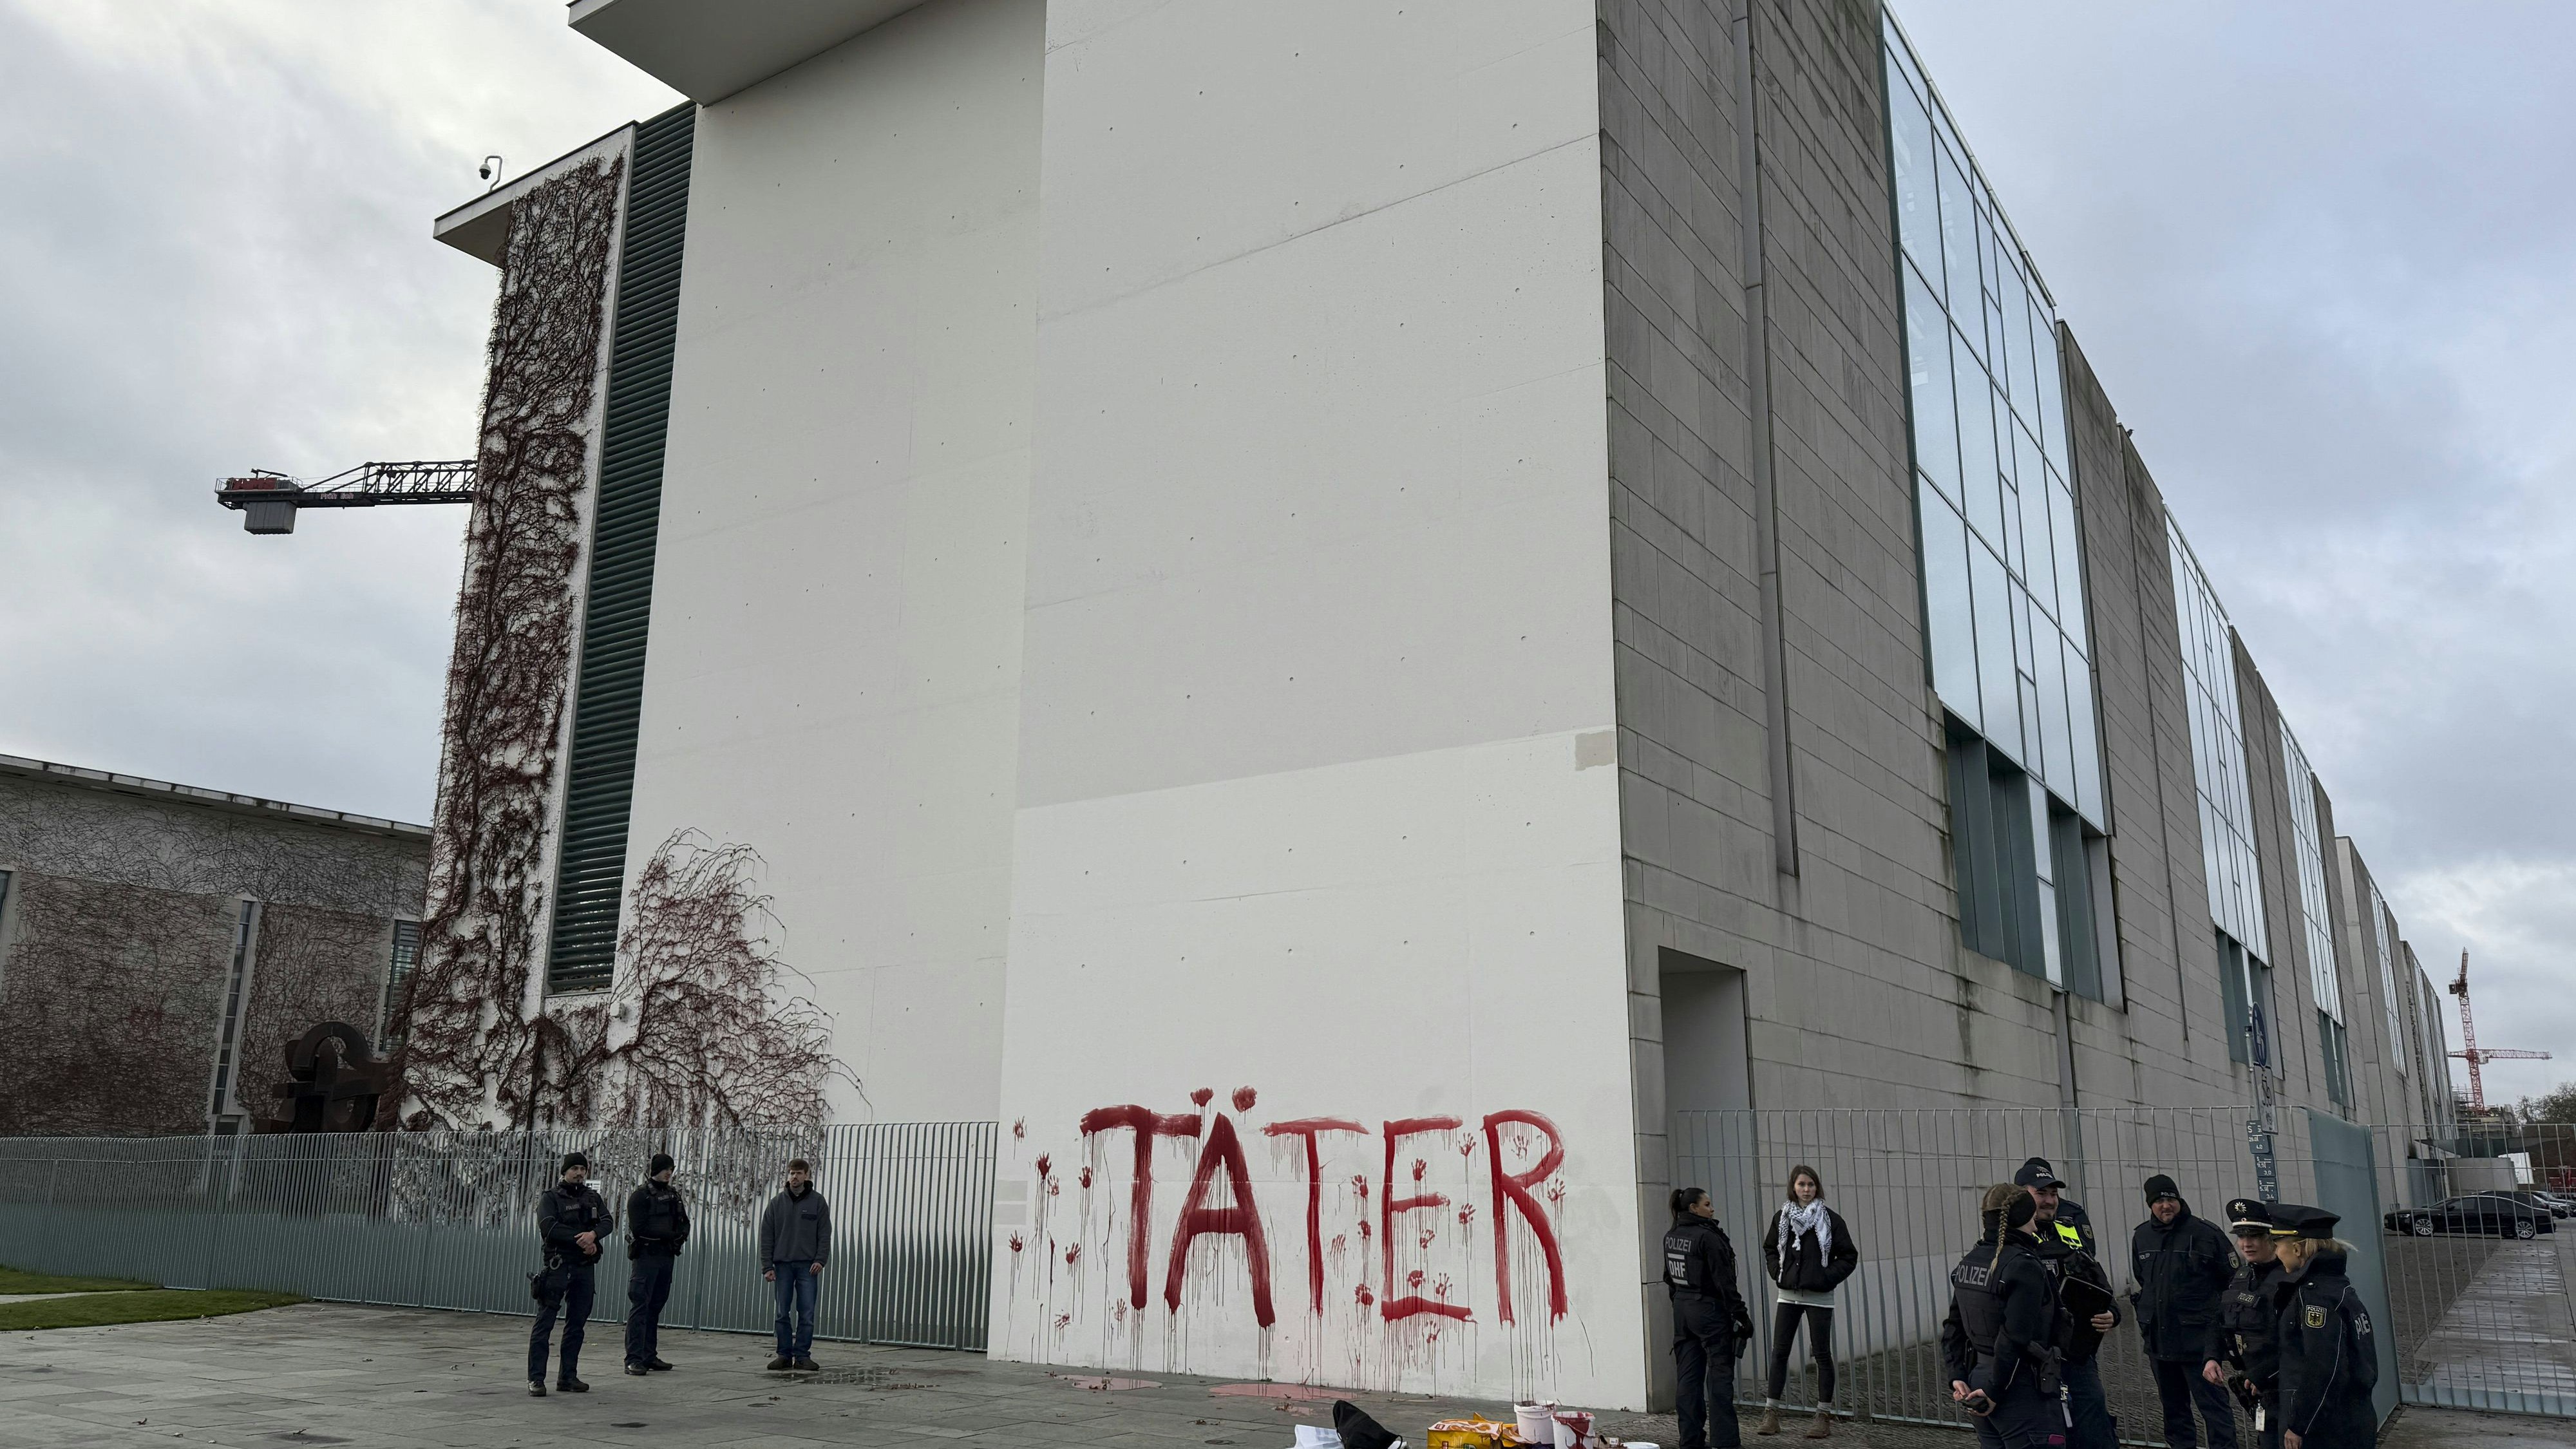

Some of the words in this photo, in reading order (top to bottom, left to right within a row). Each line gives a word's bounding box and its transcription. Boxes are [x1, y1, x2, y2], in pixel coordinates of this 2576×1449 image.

[1079, 1086, 1567, 1329] TÄTER
[1665, 1236, 1692, 1253] POLIZEI
[1668, 1260, 1685, 1278] DHF
